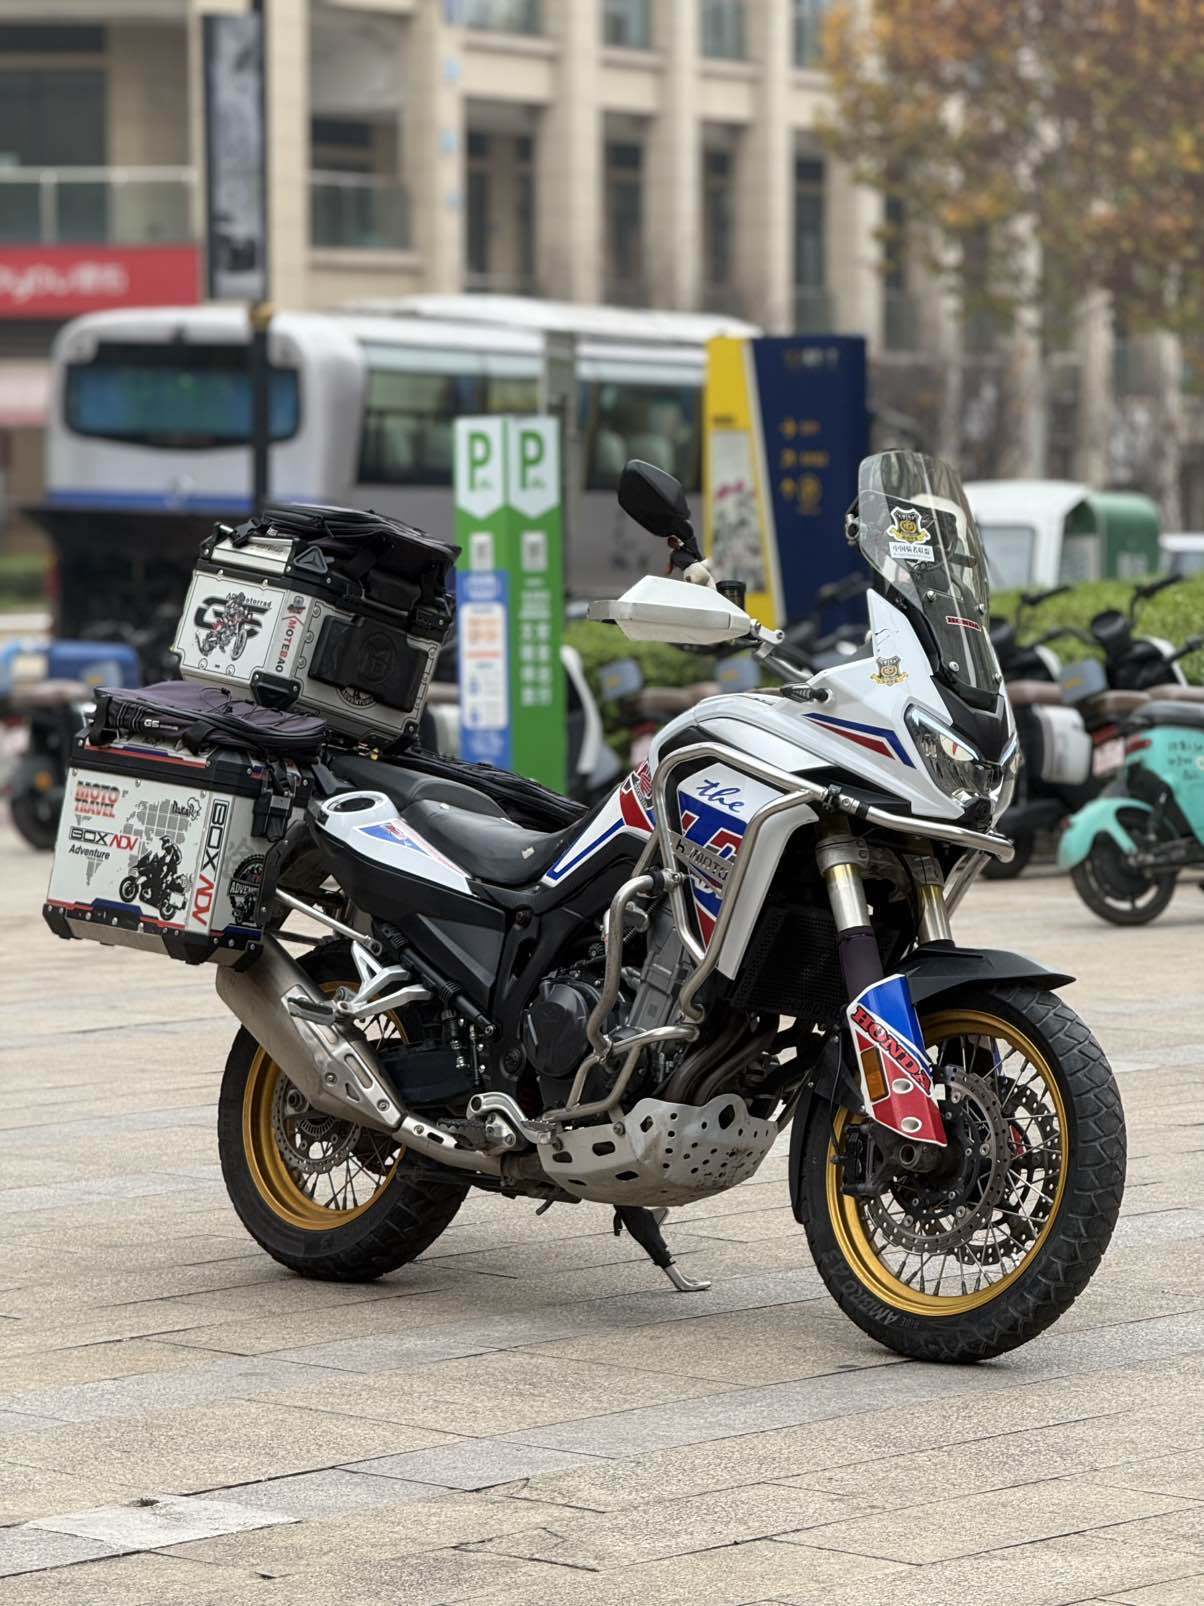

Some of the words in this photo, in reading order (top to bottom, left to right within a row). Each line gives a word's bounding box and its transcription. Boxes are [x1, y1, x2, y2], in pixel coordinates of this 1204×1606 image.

[468, 430, 492, 491] P
[520, 429, 545, 491] P
[276, 619, 298, 673] MOTEBAO
[144, 719, 160, 728] GS
[76, 780, 120, 804] MOTO
[696, 778, 745, 813] the
[69, 843, 111, 860] Adventure
[850, 1006, 933, 1098] HONDA
